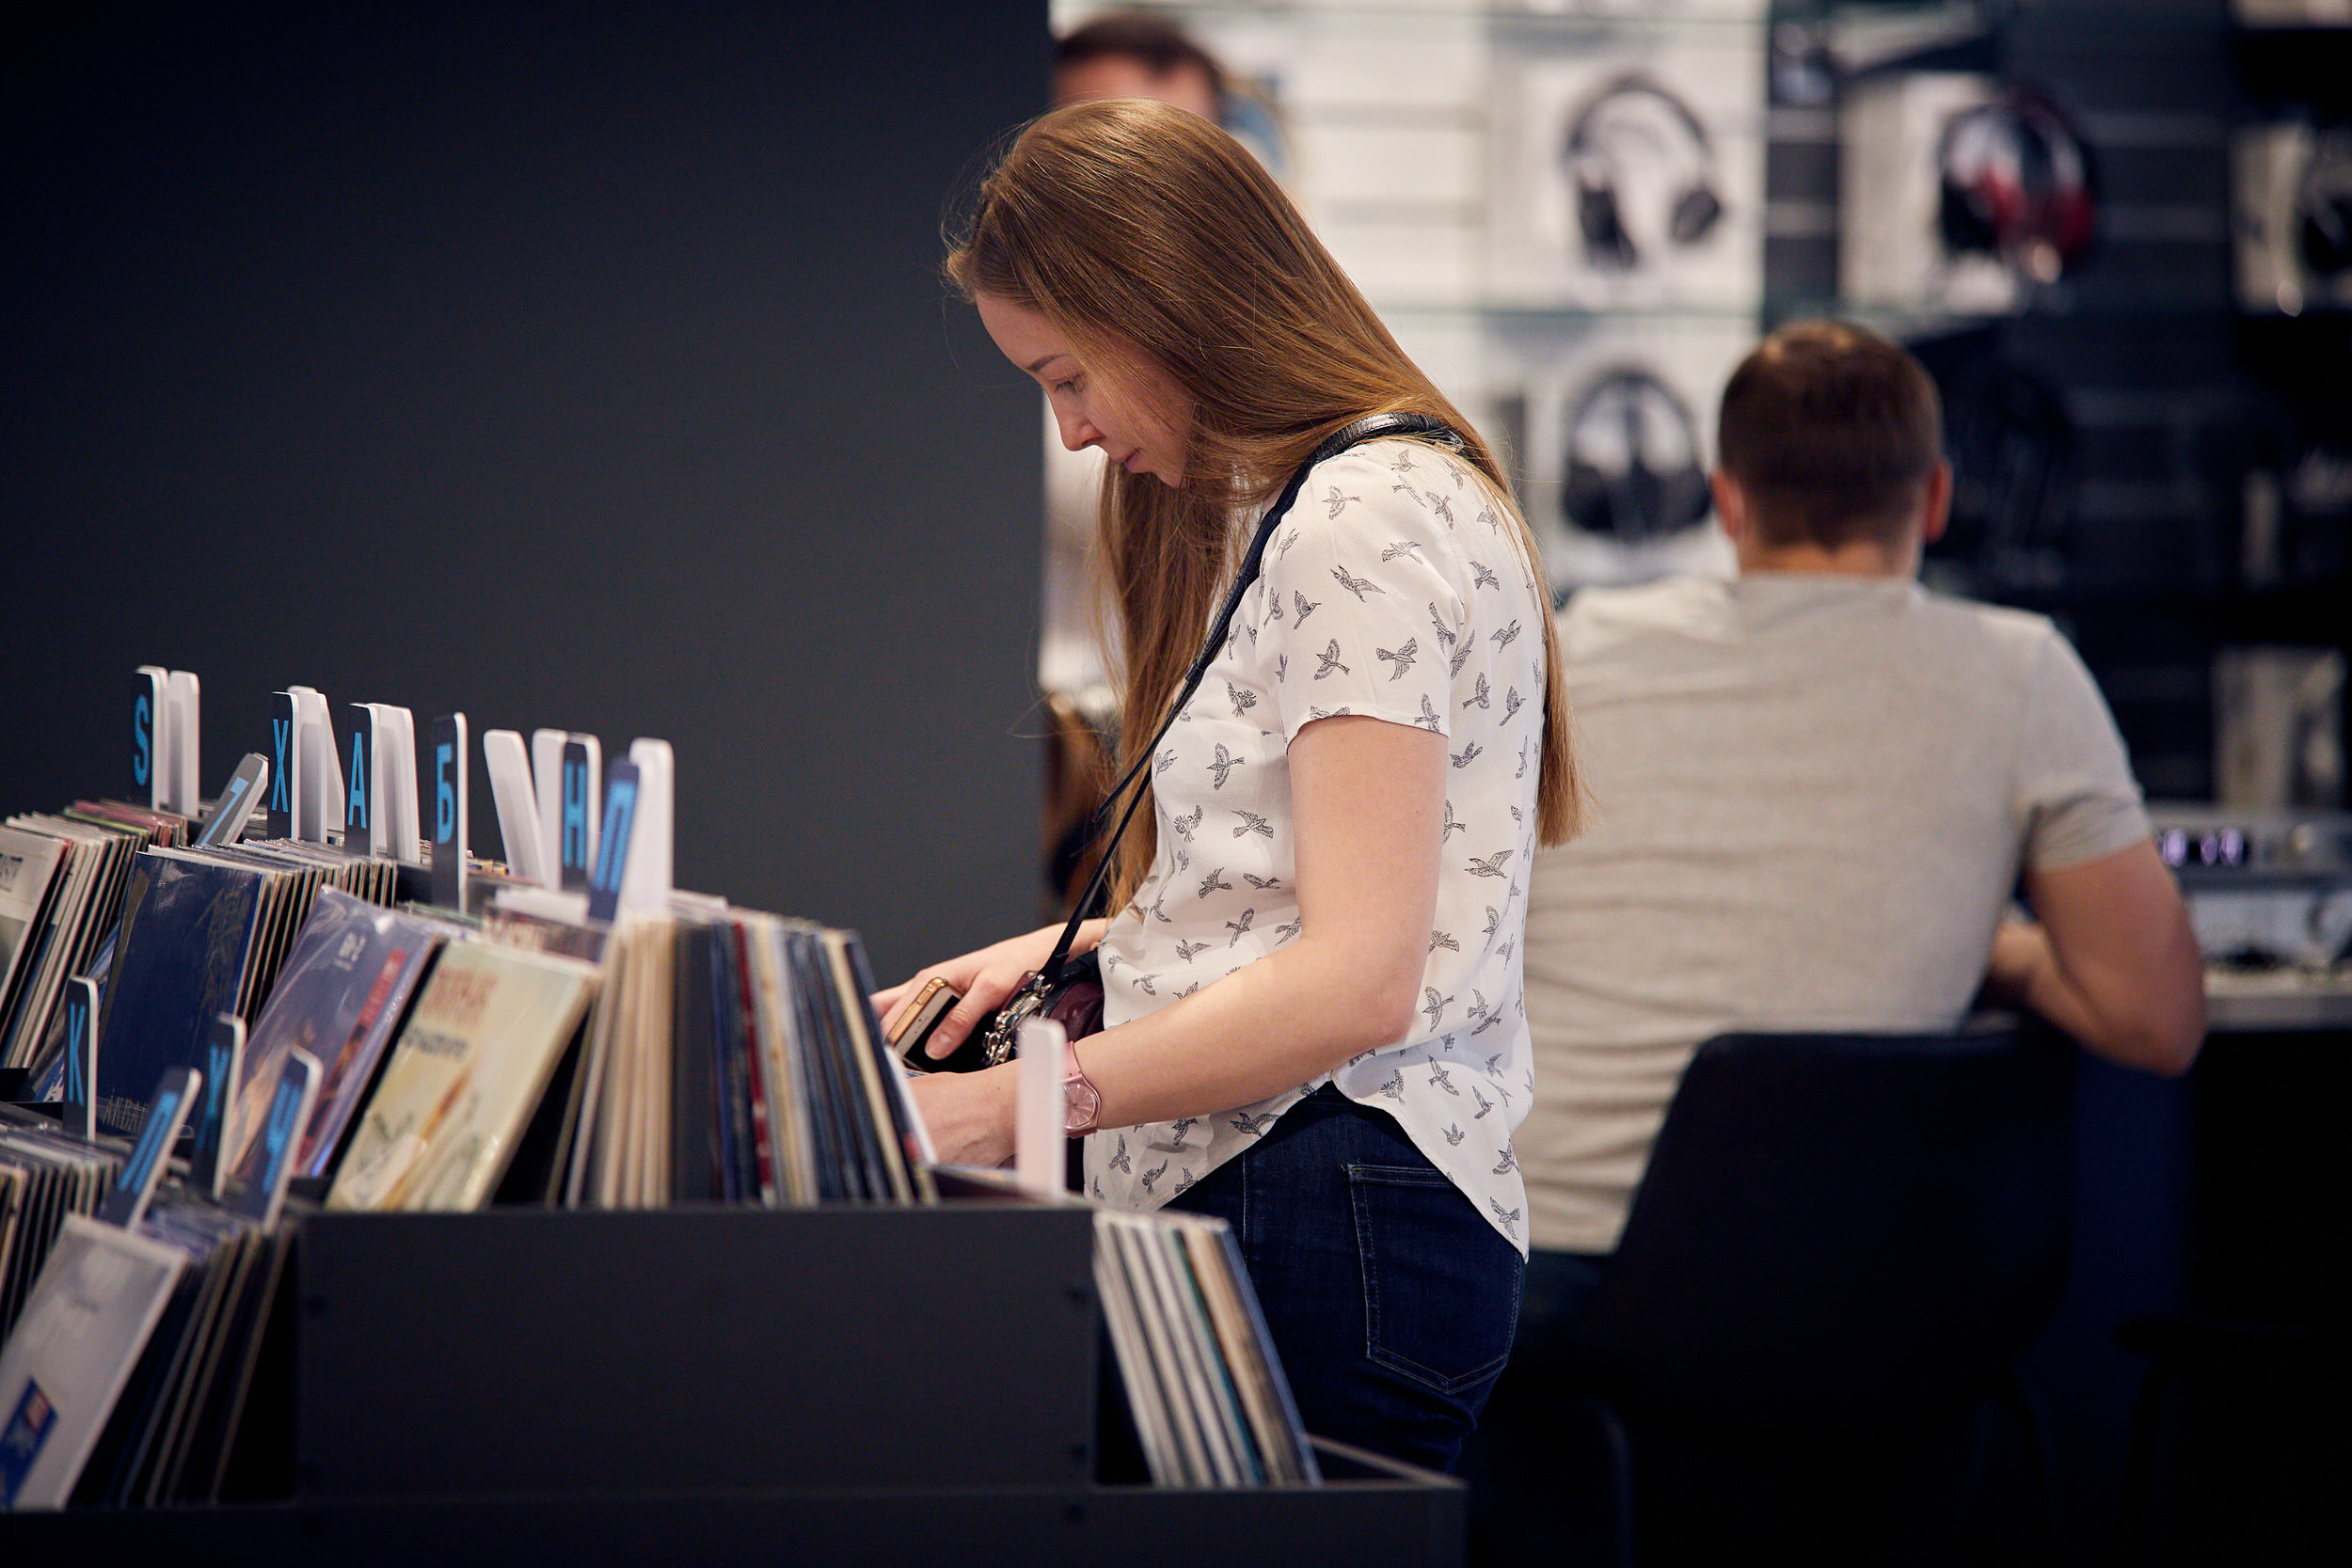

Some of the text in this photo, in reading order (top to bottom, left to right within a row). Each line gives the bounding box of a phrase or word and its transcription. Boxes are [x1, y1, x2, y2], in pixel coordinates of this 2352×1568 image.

[134, 695, 149, 785] S
[437, 743, 453, 844] Б
[594, 779, 637, 894] П
